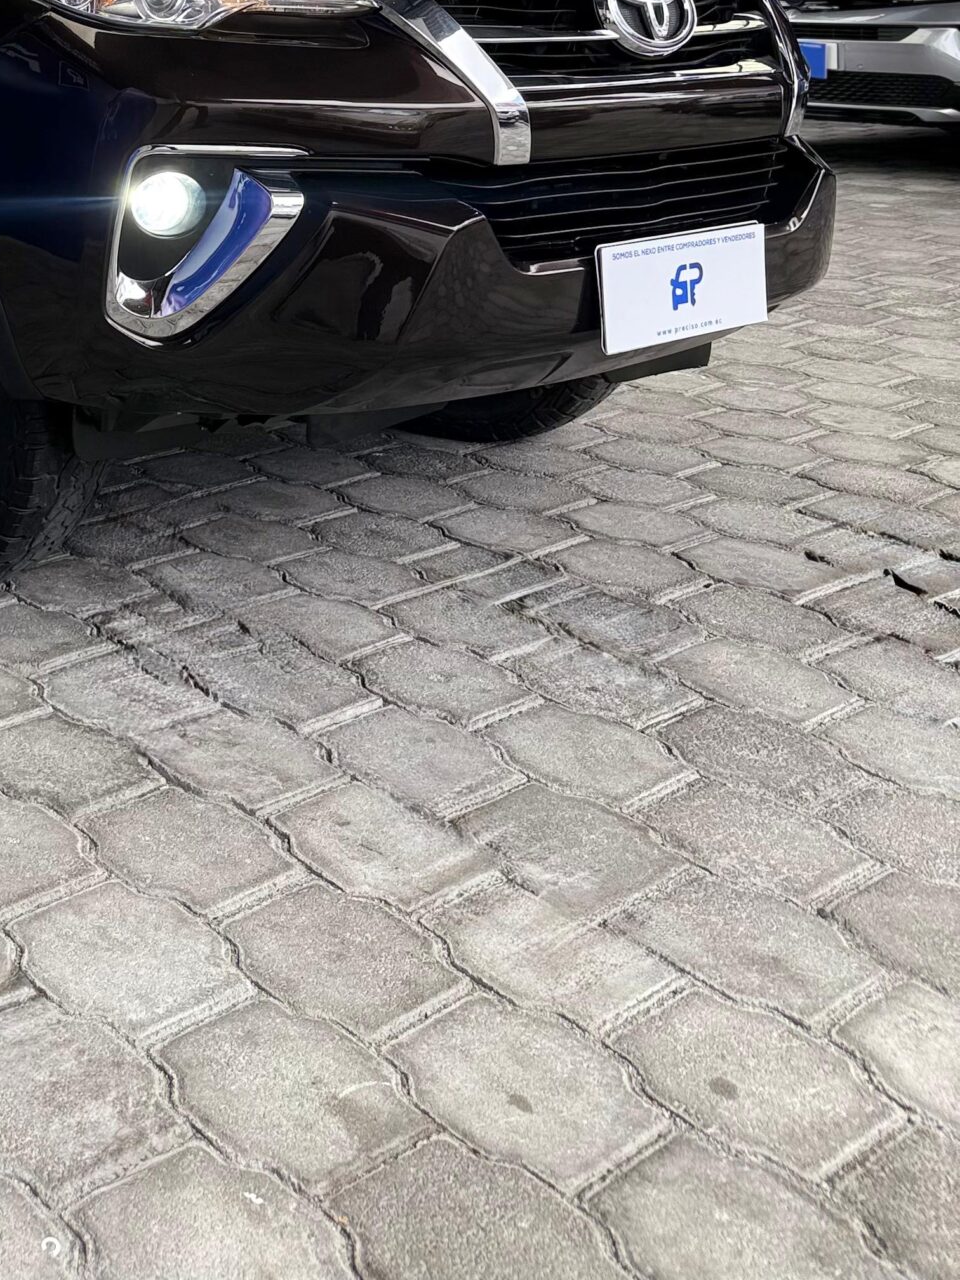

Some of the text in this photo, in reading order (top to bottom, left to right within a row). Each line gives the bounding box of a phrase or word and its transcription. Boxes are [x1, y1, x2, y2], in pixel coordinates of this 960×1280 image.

[612, 250, 633, 261] SOMOS
[633, 250, 641, 258] EL
[641, 247, 656, 256] NEXO
[657, 245, 675, 254] ENTRE
[675, 238, 717, 251] COMPRADORES
[721, 231, 756, 244] VENDEDORES
